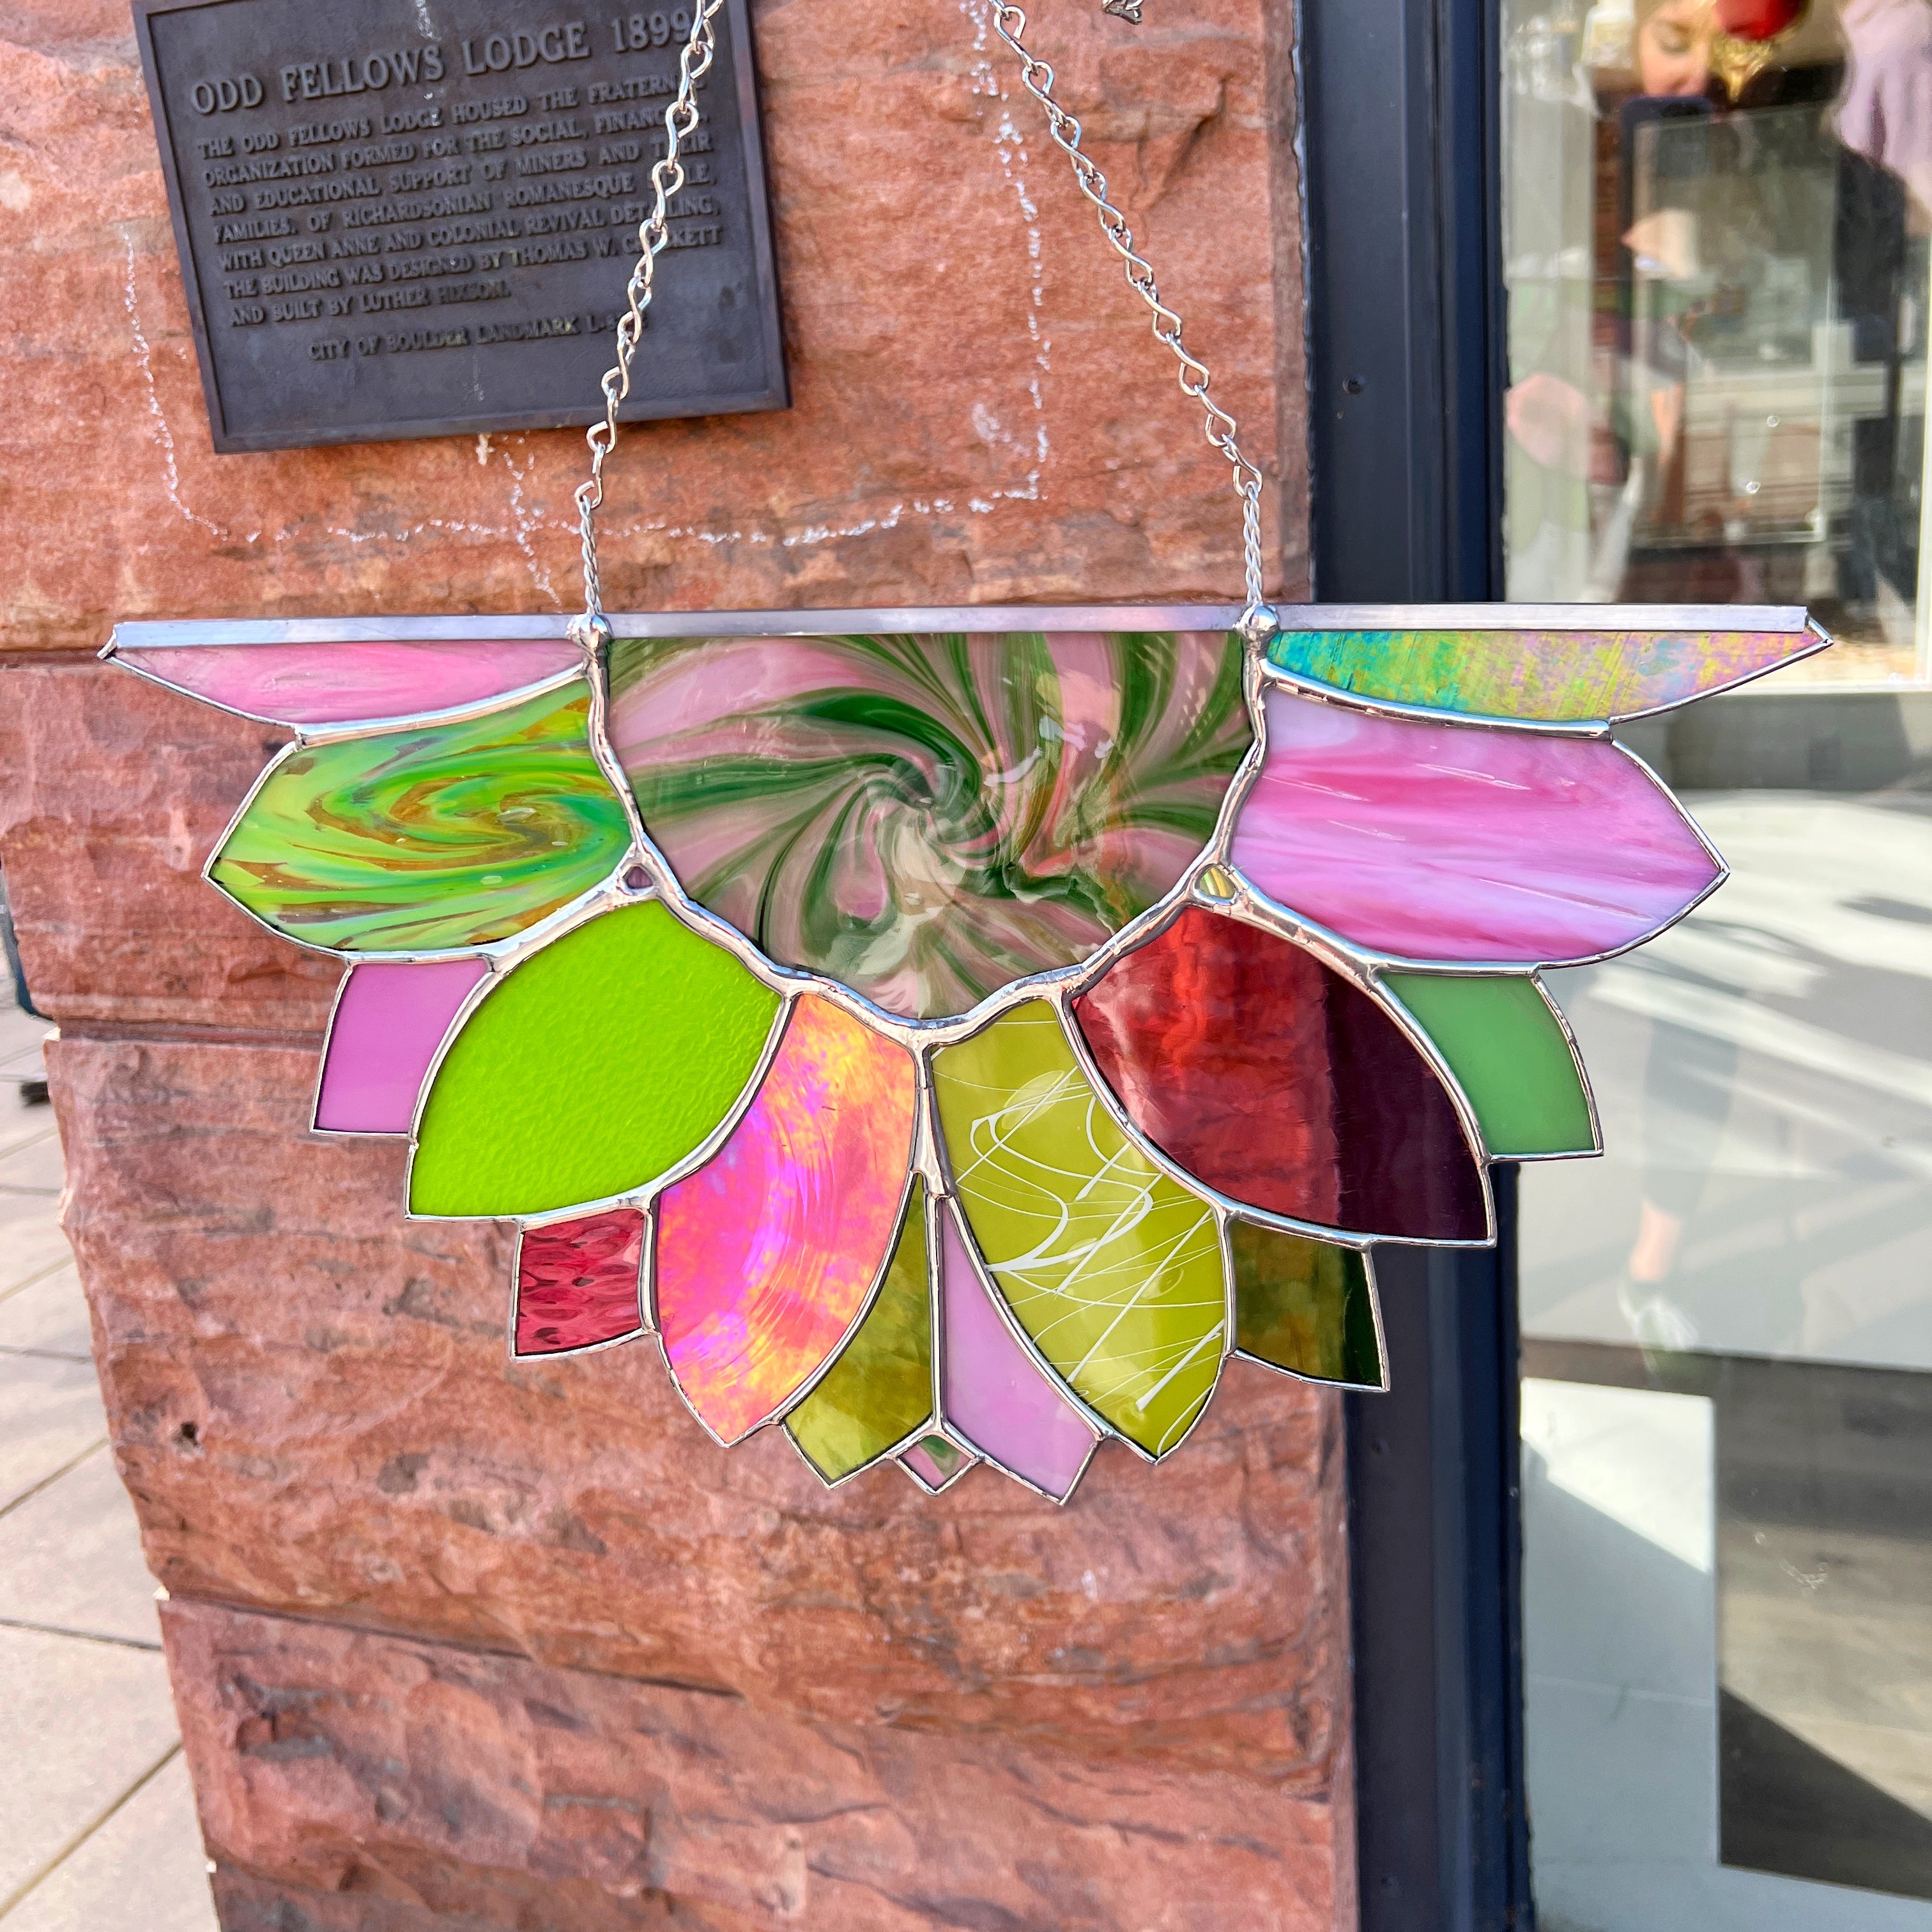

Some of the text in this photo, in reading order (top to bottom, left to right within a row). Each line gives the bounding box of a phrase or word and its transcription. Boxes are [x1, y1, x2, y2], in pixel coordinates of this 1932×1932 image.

[192, 8, 691, 115] ODD FELLOWS LODGE 1899
[198, 72, 707, 158] THE ODD FELLOWS LODGE HOUSED THE FRATERNL
[205, 153, 335, 187] ORGANIZATION
[341, 142, 415, 169] FORMED
[423, 135, 461, 158] FOR
[466, 129, 505, 153] THE
[511, 119, 588, 146] SOCIAL,
[211, 130, 714, 216] AND EDUCATIONAL SUPPORT OF MINERS AND TEIR
[214, 217, 298, 243] FAMILIES.
[307, 211, 332, 232] OF
[342, 192, 491, 228] RICHARDSONIAN
[504, 173, 636, 209] ROMANESQUE
[220, 194, 721, 272] WITH QUEEN ANNE AND COLONIAL REVIVAL DETLING,
[224, 278, 258, 299] THE
[261, 268, 341, 295] BUILDING
[344, 263, 384, 285] WAS
[388, 255, 473, 281] DESIGNED
[480, 250, 503, 270] BY
[509, 237, 587, 268] THOMAS
[231, 305, 266, 327] AND
[270, 297, 322, 322] BUILT
[328, 296, 353, 316] BY
[358, 288, 431, 312] LUTHER
[308, 339, 350, 360] CITY
[357, 335, 381, 356] OF
[385, 326, 470, 353] BOULDER
[476, 315, 581, 345] LANDMARK
